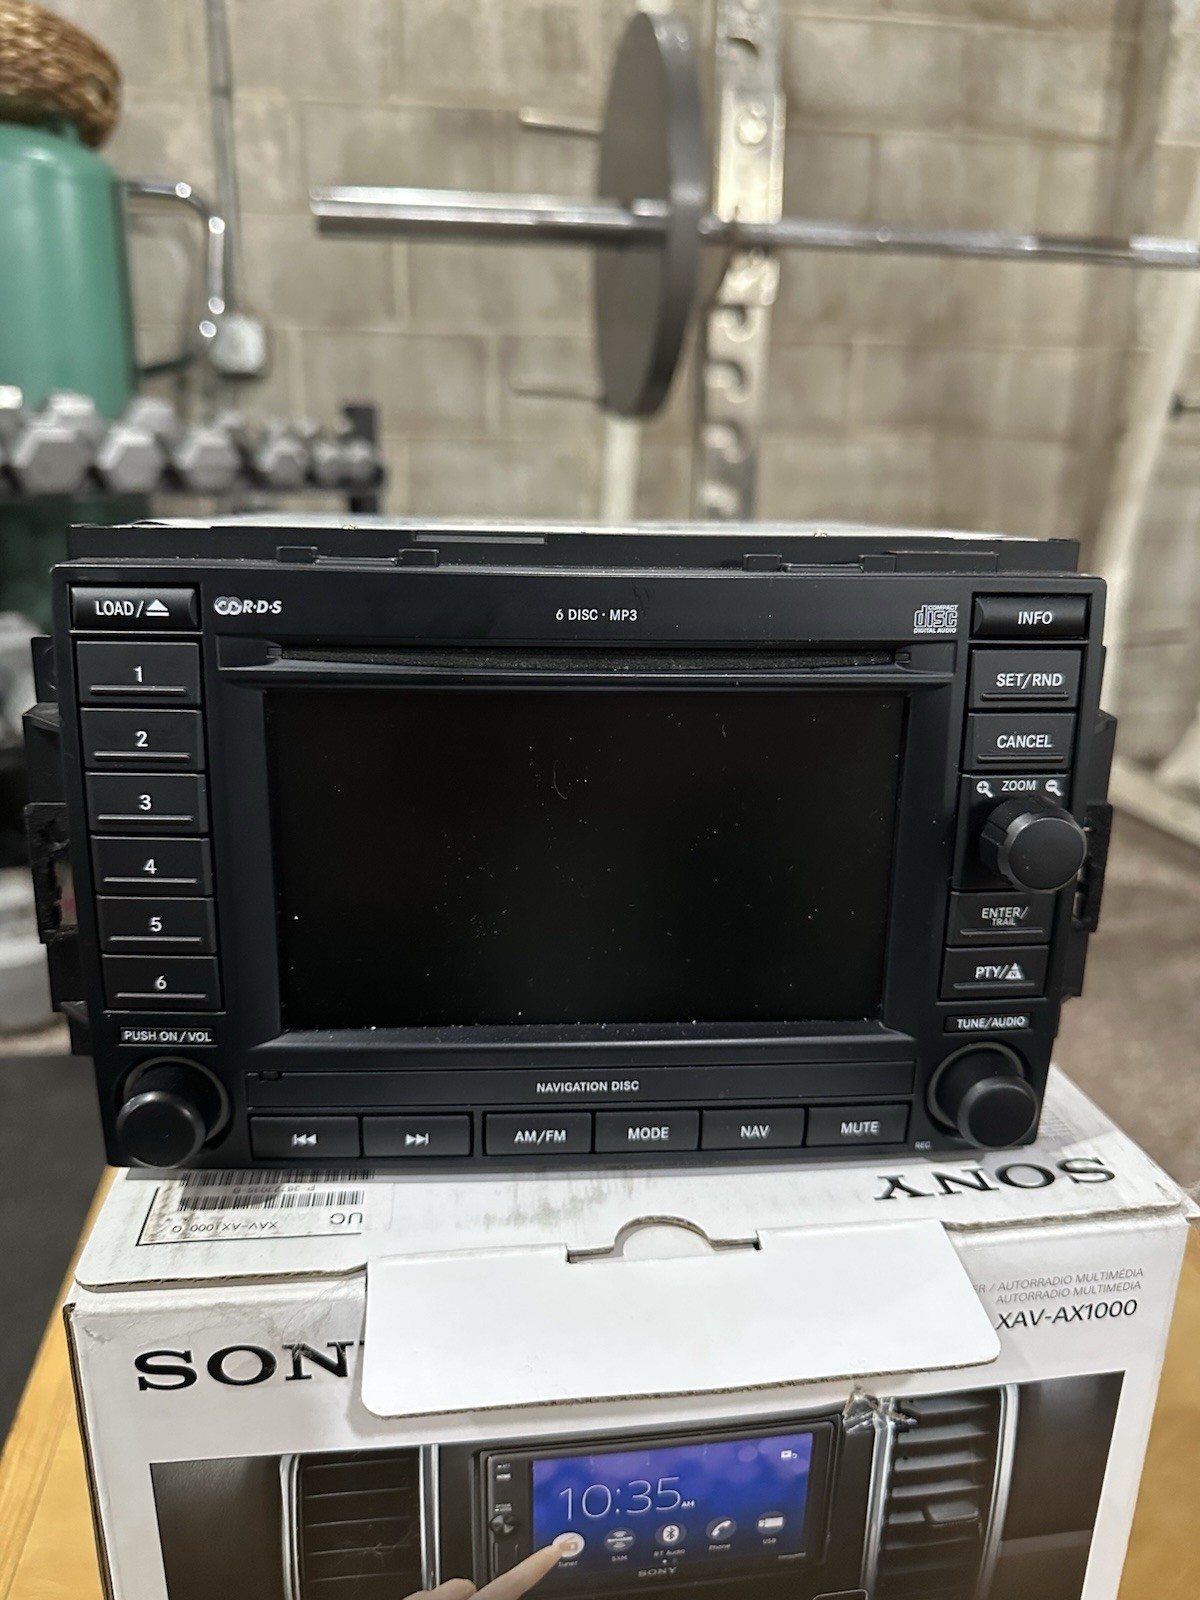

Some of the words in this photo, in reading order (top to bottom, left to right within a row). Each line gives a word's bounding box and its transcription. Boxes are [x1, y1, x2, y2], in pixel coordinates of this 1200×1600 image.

[555, 608, 565, 621] 6
[567, 608, 599, 621] DISC
[609, 609, 638, 621] MP3
[1017, 610, 1054, 626] INFO
[913, 626, 937, 634] DIGITAL
[936, 626, 957, 634] AUDIO
[134, 665, 143, 683] 1
[995, 672, 1064, 690] SET/RND
[135, 730, 149, 748] 2
[996, 734, 1053, 749] CANCEL
[1001, 779, 1037, 792] ZOOM
[138, 793, 152, 811] 3
[142, 858, 158, 875] 4
[981, 905, 1029, 920] ENTER/
[149, 916, 163, 932] 5
[991, 917, 1017, 927] TRAIL
[153, 975, 168, 990] 6
[956, 1015, 1027, 1030] TUNE/AUDIO
[123, 1029, 157, 1042] PUSH
[536, 1081, 609, 1093] NAVIGATION
[611, 1079, 640, 1092] DISC
[627, 1126, 670, 1142] MODE
[740, 1124, 770, 1139] NAV
[840, 1120, 880, 1136] MUTE
[513, 1129, 568, 1145] AM/FM
[874, 1156, 1116, 1200] SONY
[189, 1220, 279, 1233] XAV-AX1000
[329, 1211, 364, 1226] UC
[997, 1274, 1073, 1292] AUTORRADIO
[1074, 1267, 1144, 1284] MULTIMÉDIA
[995, 1287, 1070, 1305] AUTORRADIO
[1072, 1280, 1142, 1297] MULTIMEDIA
[994, 1298, 1138, 1330] XAV-AX1000
[133, 1340, 364, 1391] SON
[558, 1475, 682, 1522] 10:35
[681, 1500, 695, 1510] AM
[637, 1565, 678, 1578] SONY
